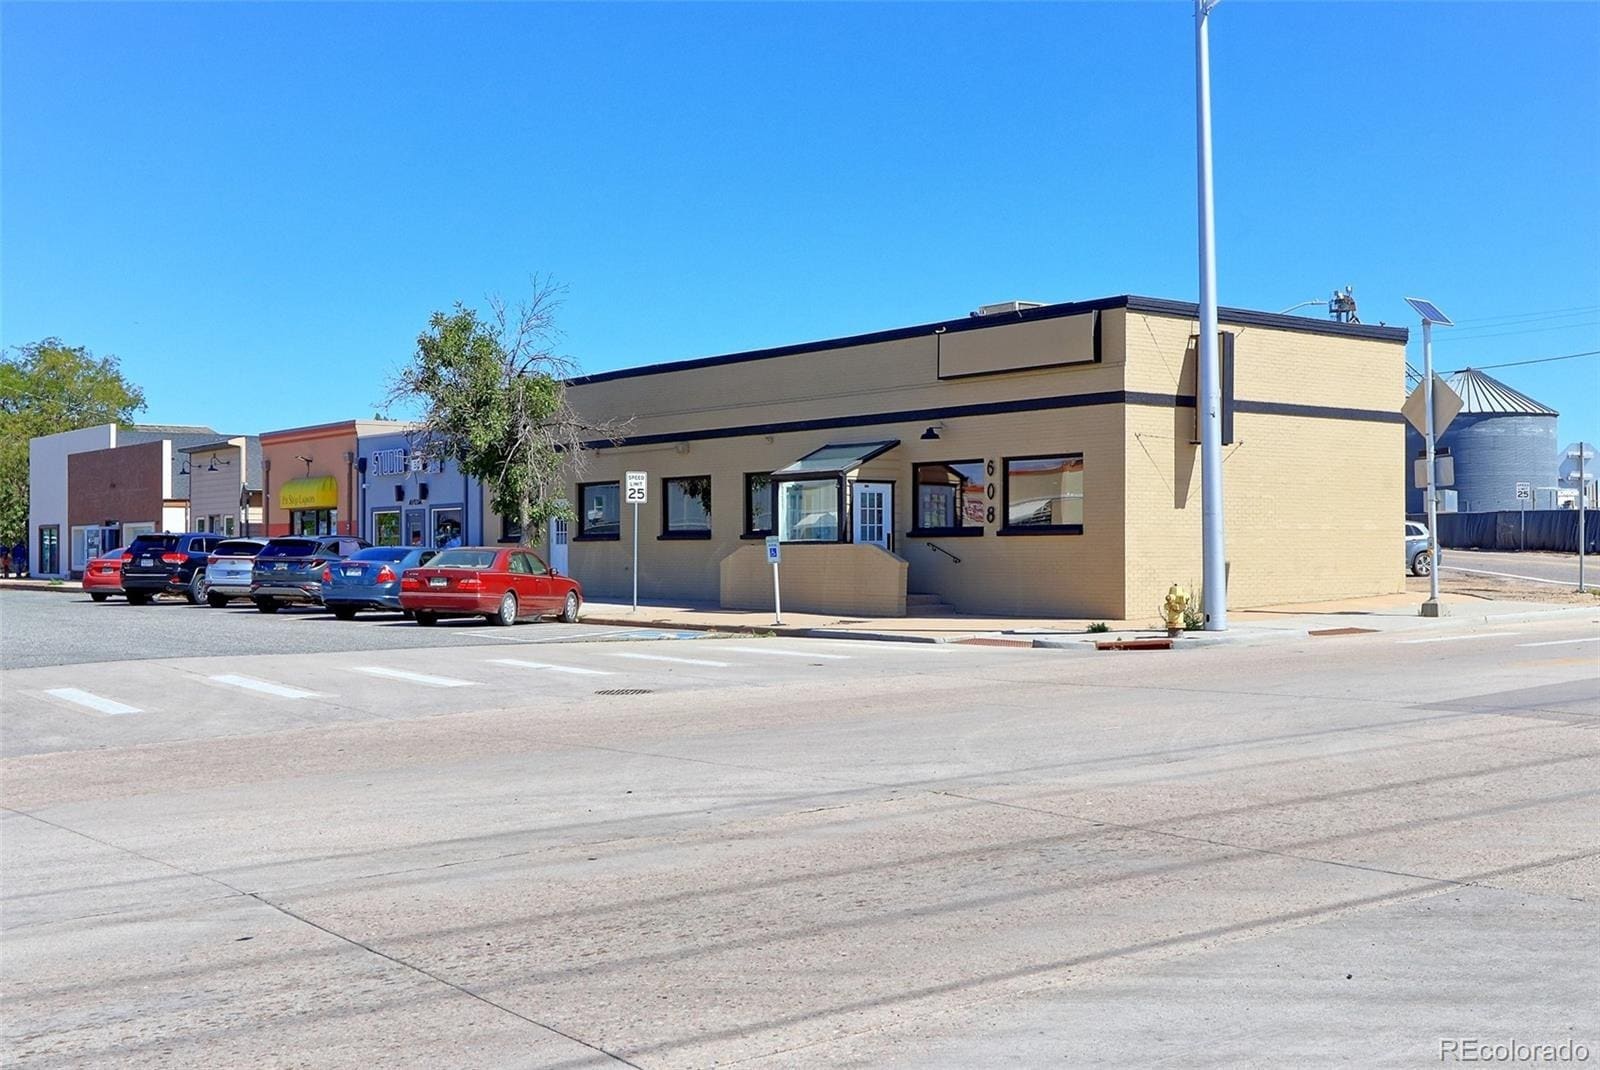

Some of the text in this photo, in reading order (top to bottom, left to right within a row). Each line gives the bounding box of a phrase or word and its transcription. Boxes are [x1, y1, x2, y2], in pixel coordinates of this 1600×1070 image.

[628, 488, 645, 500] 25
[986, 459, 996, 524] 608
[1517, 490, 1529, 498] 25
